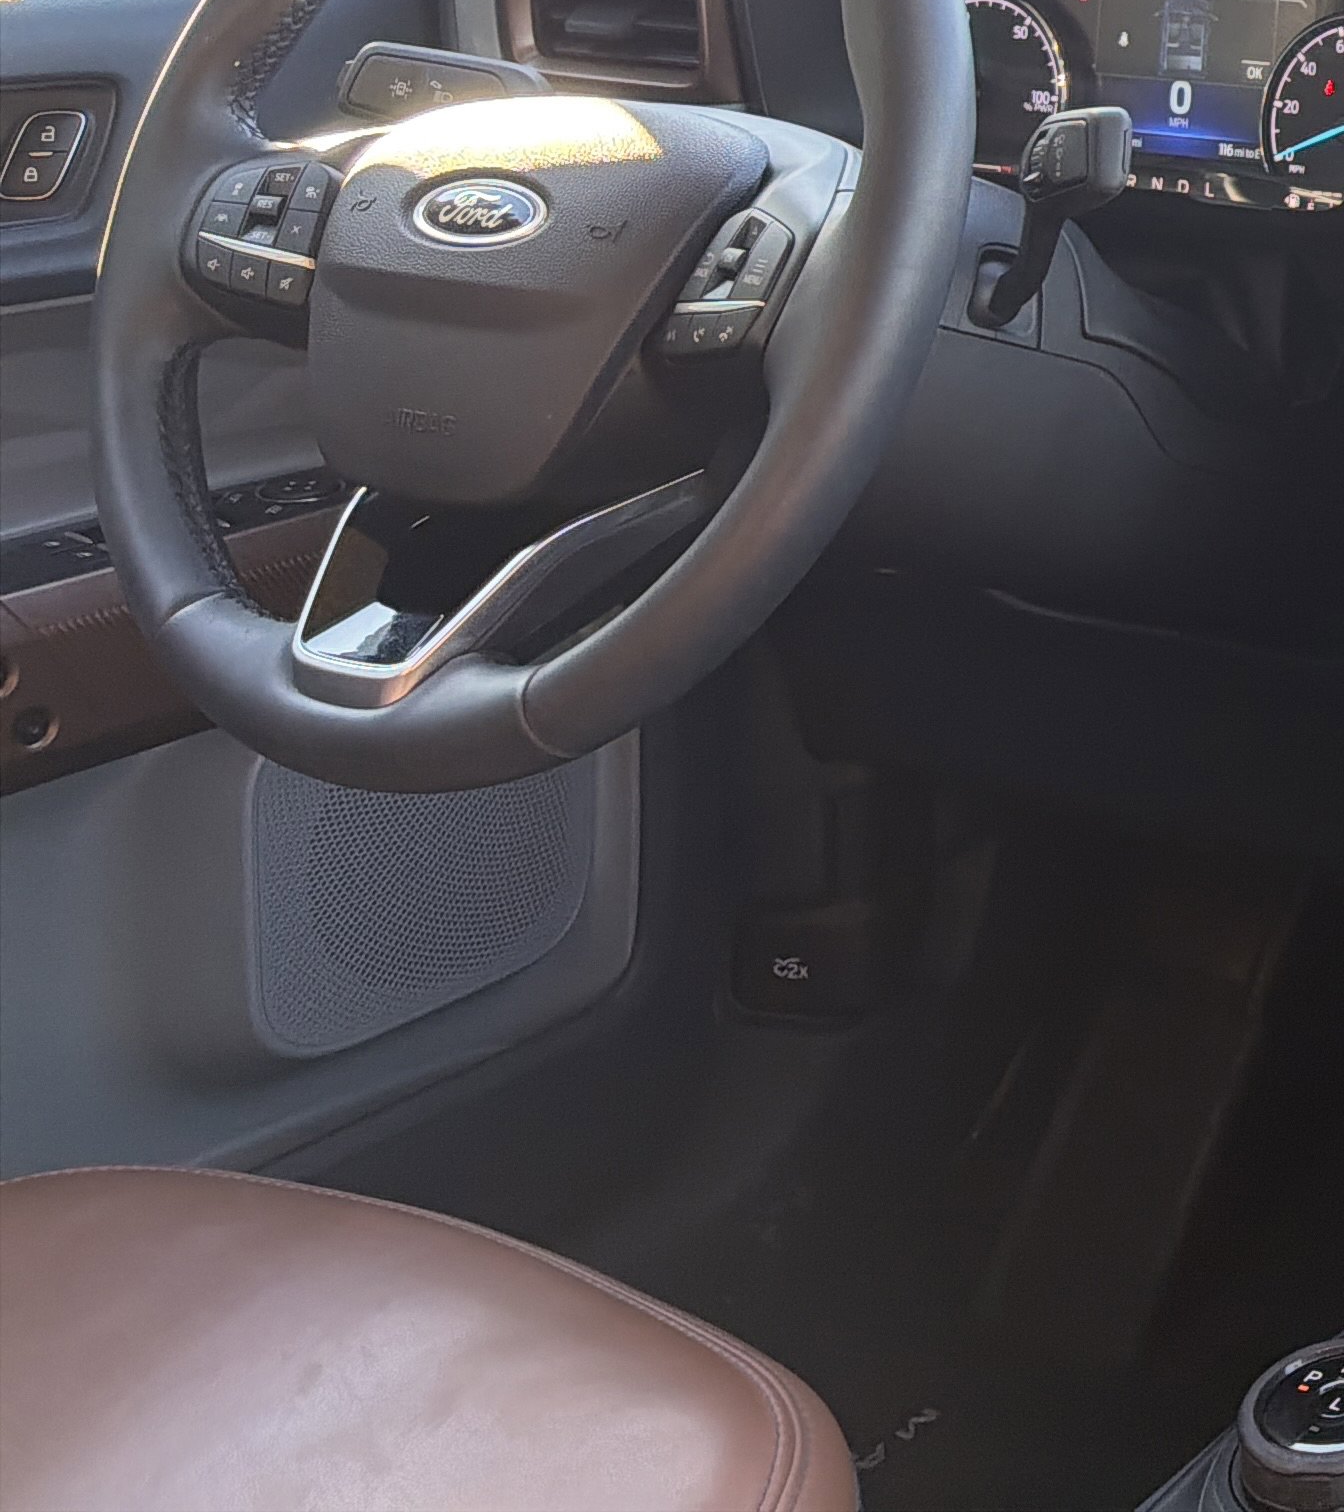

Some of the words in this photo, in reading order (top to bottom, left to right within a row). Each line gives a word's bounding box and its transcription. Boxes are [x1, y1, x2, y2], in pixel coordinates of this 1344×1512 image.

[1013, 25, 1028, 40] 50
[1246, 65, 1263, 81] OK
[1300, 61, 1317, 76] 40
[1032, 90, 1051, 104] 100
[1169, 80, 1192, 116] 0
[1283, 99, 1300, 115] 20
[1169, 117, 1189, 128] MPH
[1218, 143, 1233, 157] 116
[1234, 147, 1245, 158] mi
[1246, 148, 1255, 158] to
[1289, 164, 1306, 174] MPH
[1152, 176, 1164, 191] N
[1177, 179, 1189, 194] D
[1204, 181, 1215, 198] L
[257, 199, 273, 209] RES
[438, 190, 514, 229] Ford
[1303, 1369, 1323, 1385] P
[1329, 1397, 1342, 1412] L
